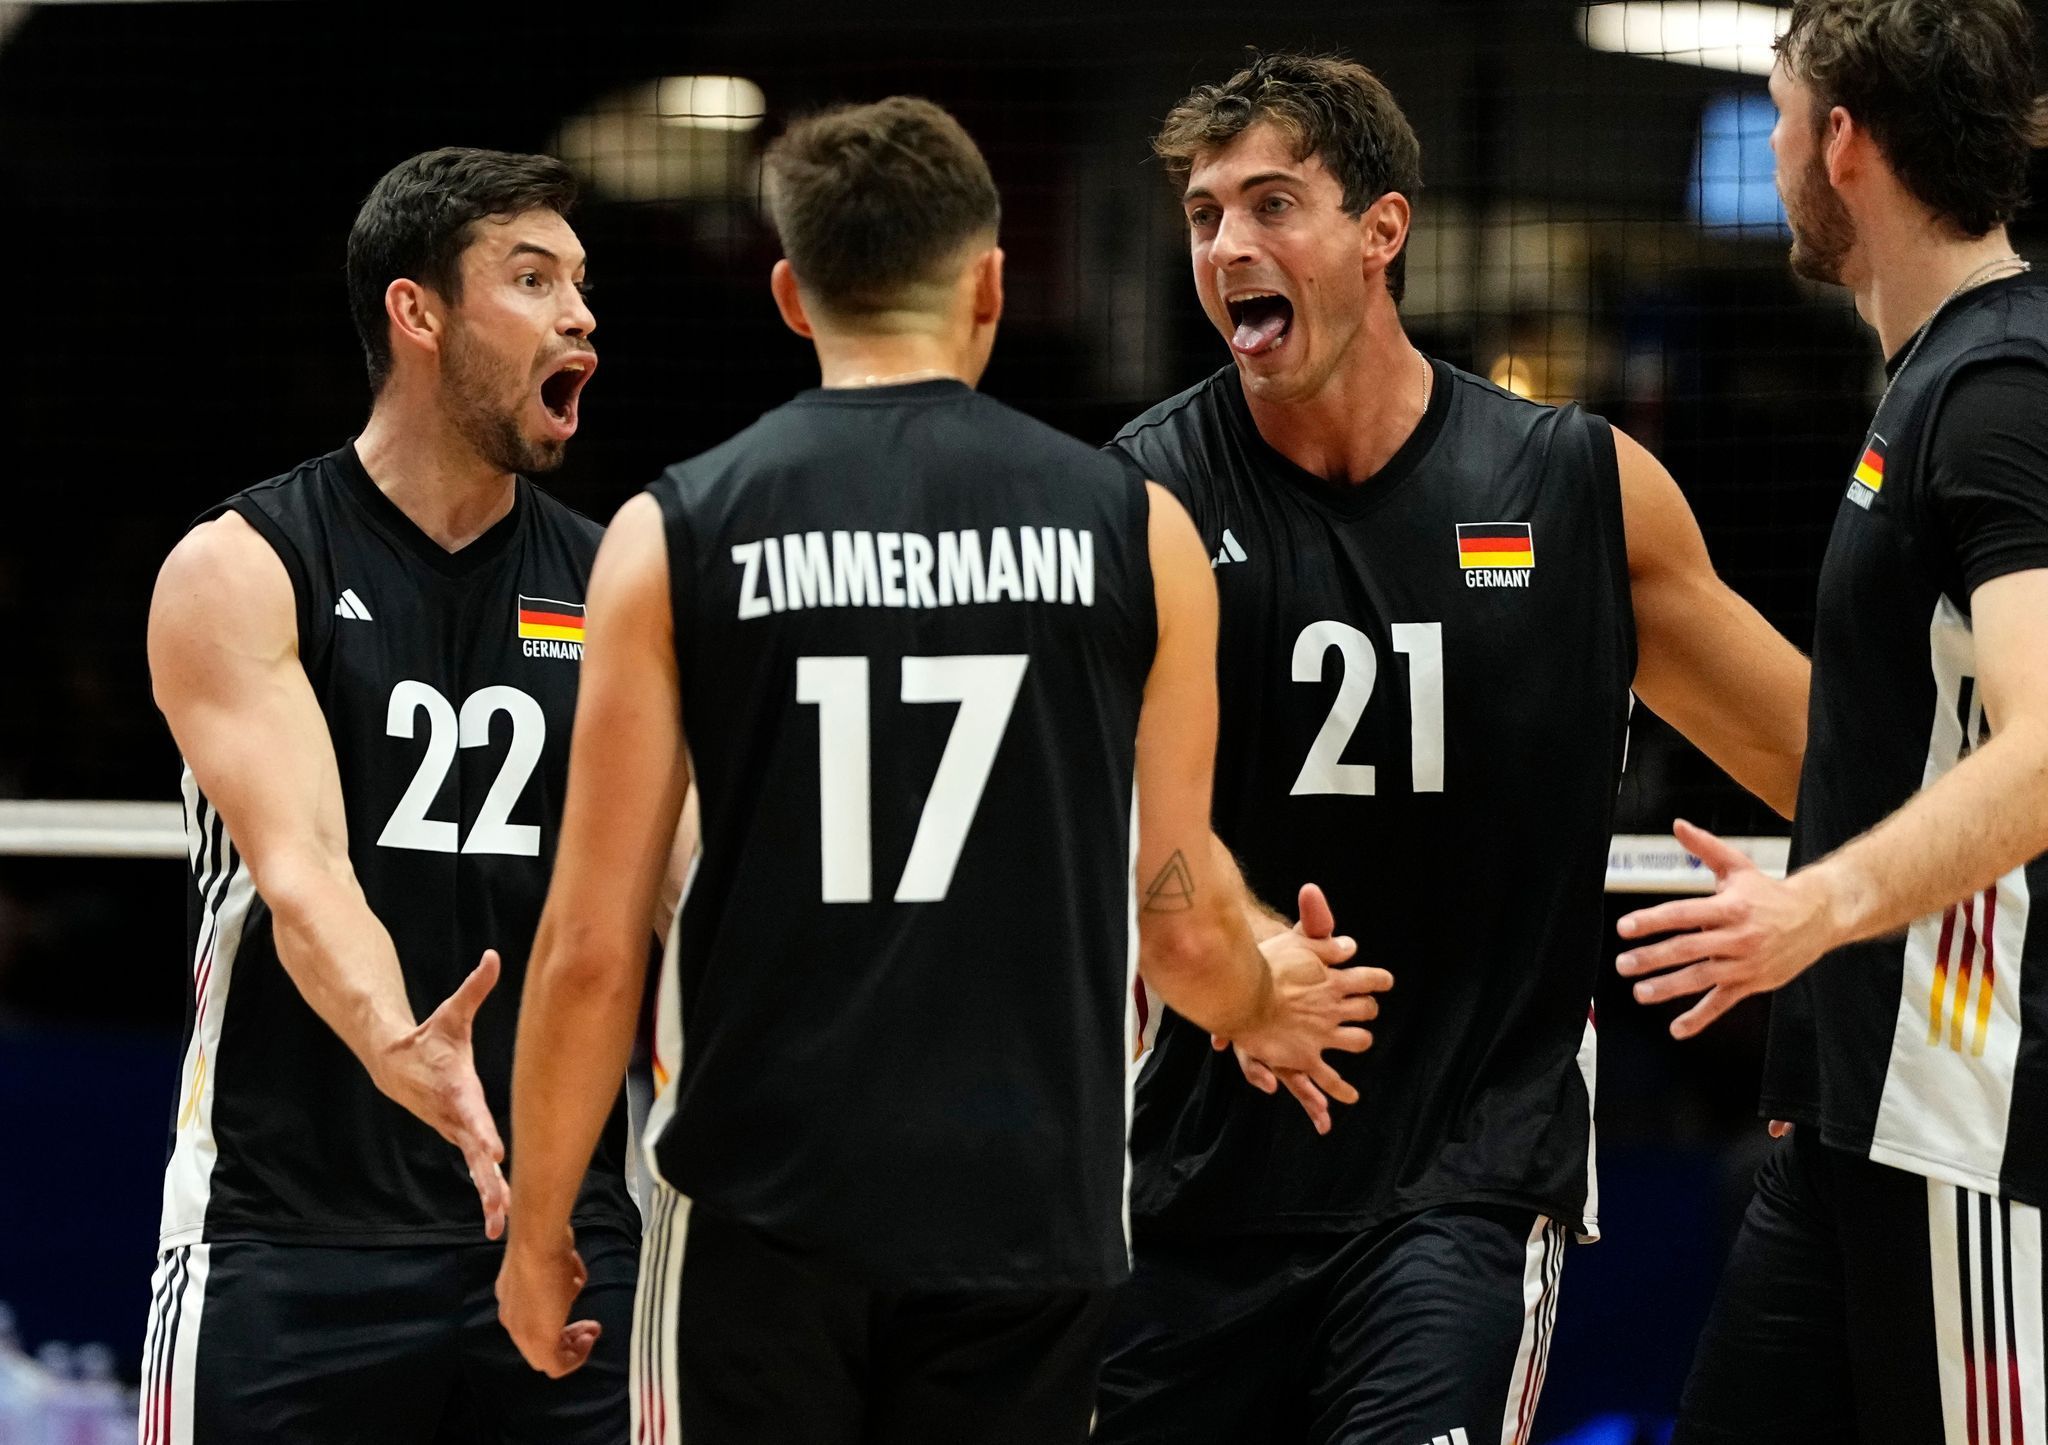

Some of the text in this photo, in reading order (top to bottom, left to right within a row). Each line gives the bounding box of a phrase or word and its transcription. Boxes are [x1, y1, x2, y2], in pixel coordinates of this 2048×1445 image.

[732, 526, 1094, 619] ZIMMERMANN
[1465, 569, 1531, 588] GERMANY
[522, 640, 584, 661] GERMANY
[1290, 621, 1444, 795] 21
[377, 680, 546, 856] 22
[796, 655, 1029, 902] 17
